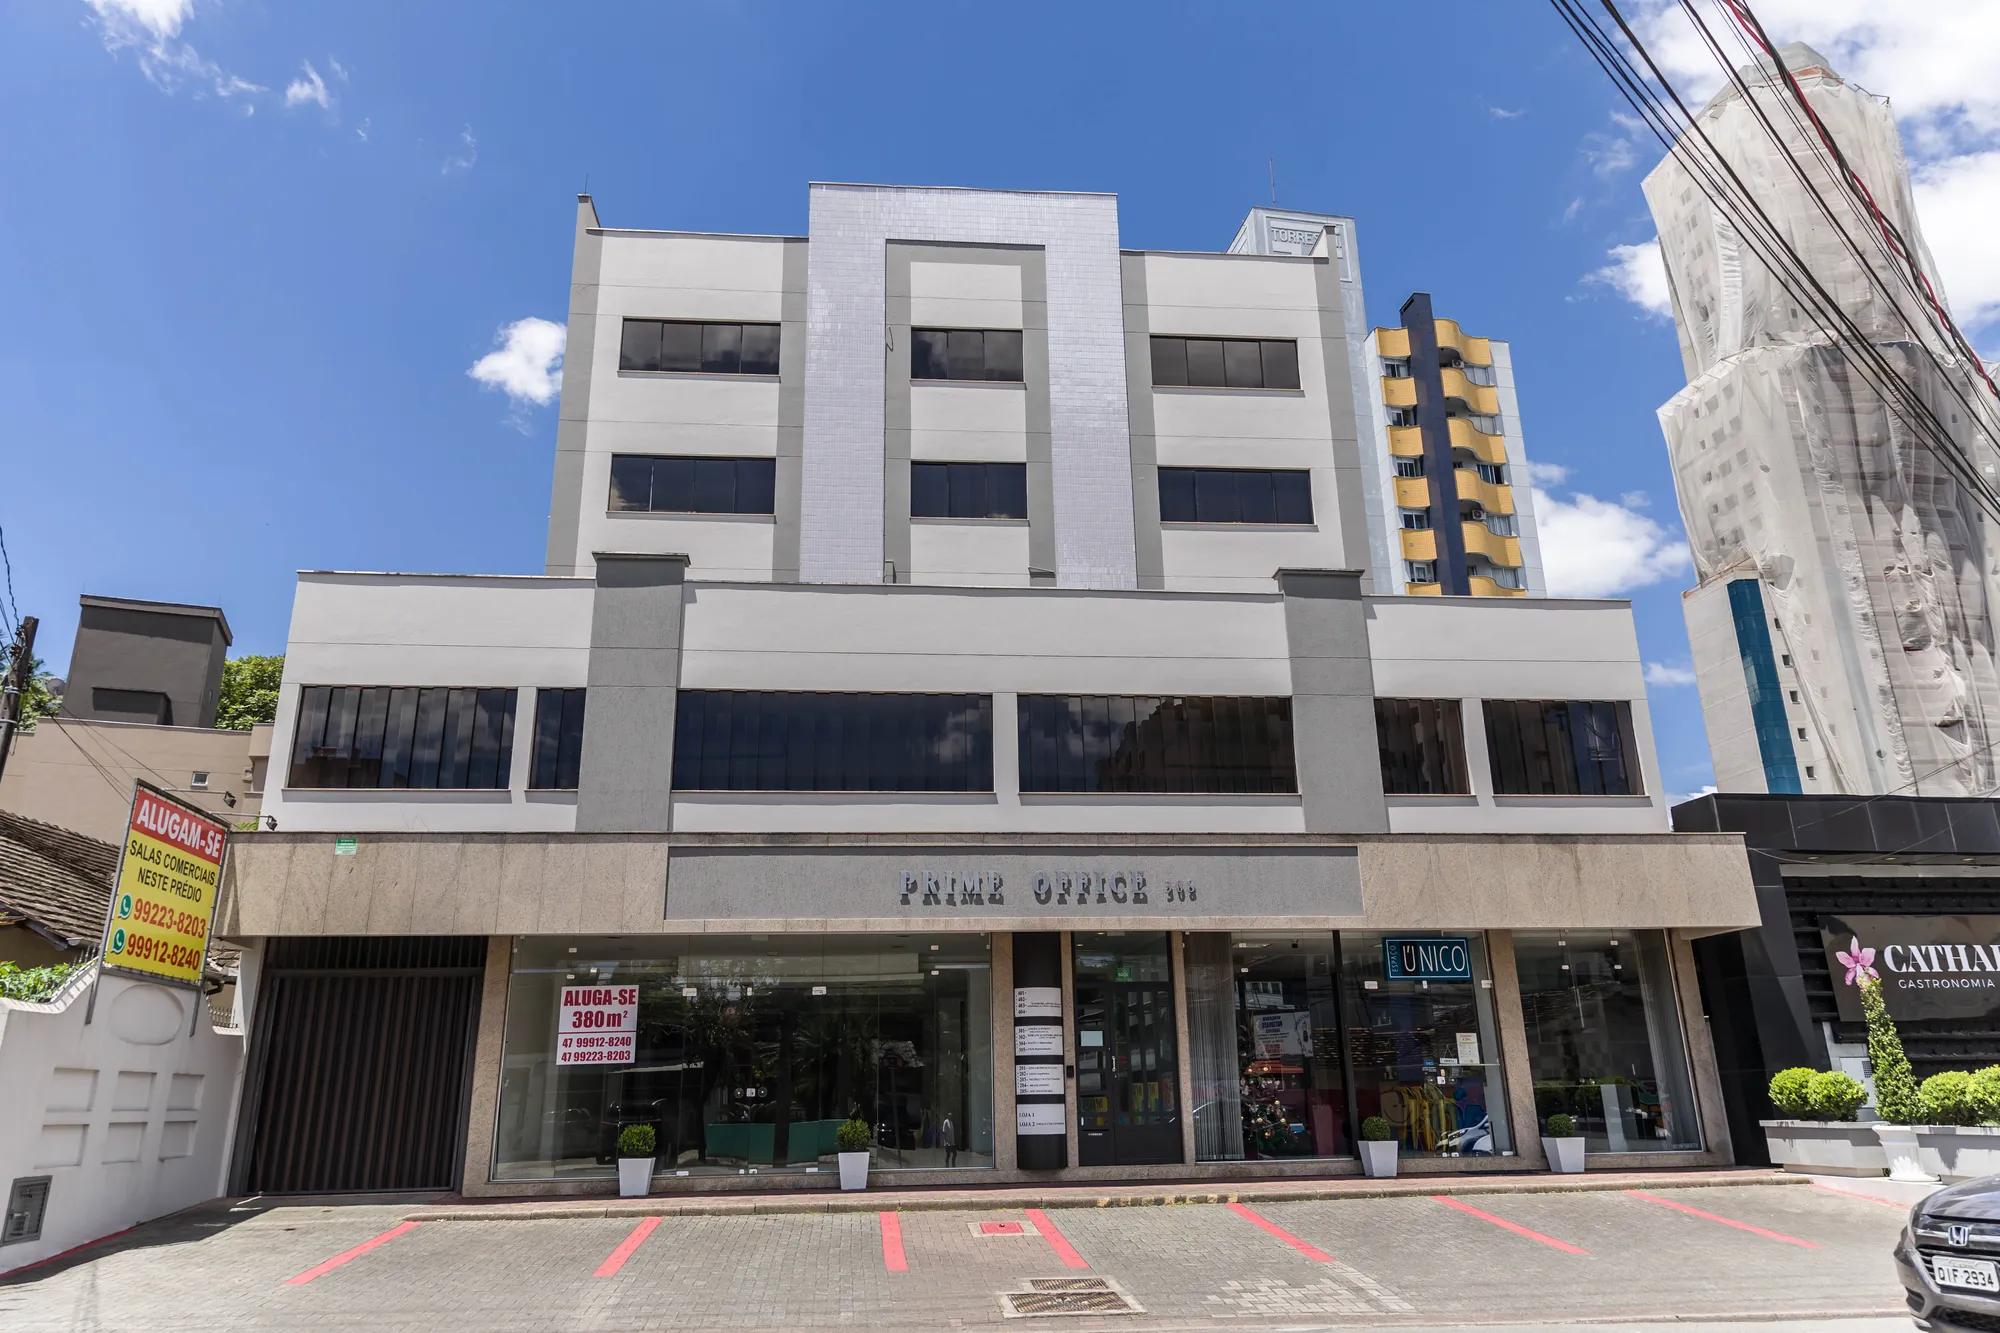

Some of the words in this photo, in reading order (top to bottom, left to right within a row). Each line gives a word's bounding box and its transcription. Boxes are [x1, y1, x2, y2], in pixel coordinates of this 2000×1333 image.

[136, 800, 222, 858] ALUGAM-SE
[129, 839, 162, 866] SALAS
[163, 853, 216, 886] COMERCIAIS
[138, 866, 168, 892] NESTE
[170, 880, 202, 903] PRÉDIO
[898, 869, 1004, 898] PRIME
[1032, 869, 1147, 898] OFFICE
[133, 898, 206, 939] 99223-8203
[126, 933, 200, 970] 99912-8240
[1402, 946, 1466, 972] ÚNICO
[564, 988, 636, 1006] ALUGA-SE
[1898, 978, 1996, 989] GASTRONOMIA
[561, 1052, 572, 1062] 47
[574, 1050, 630, 1062] 99223-8203
[562, 1038, 573, 1048] 47
[576, 1036, 632, 1048] 99912-8240
